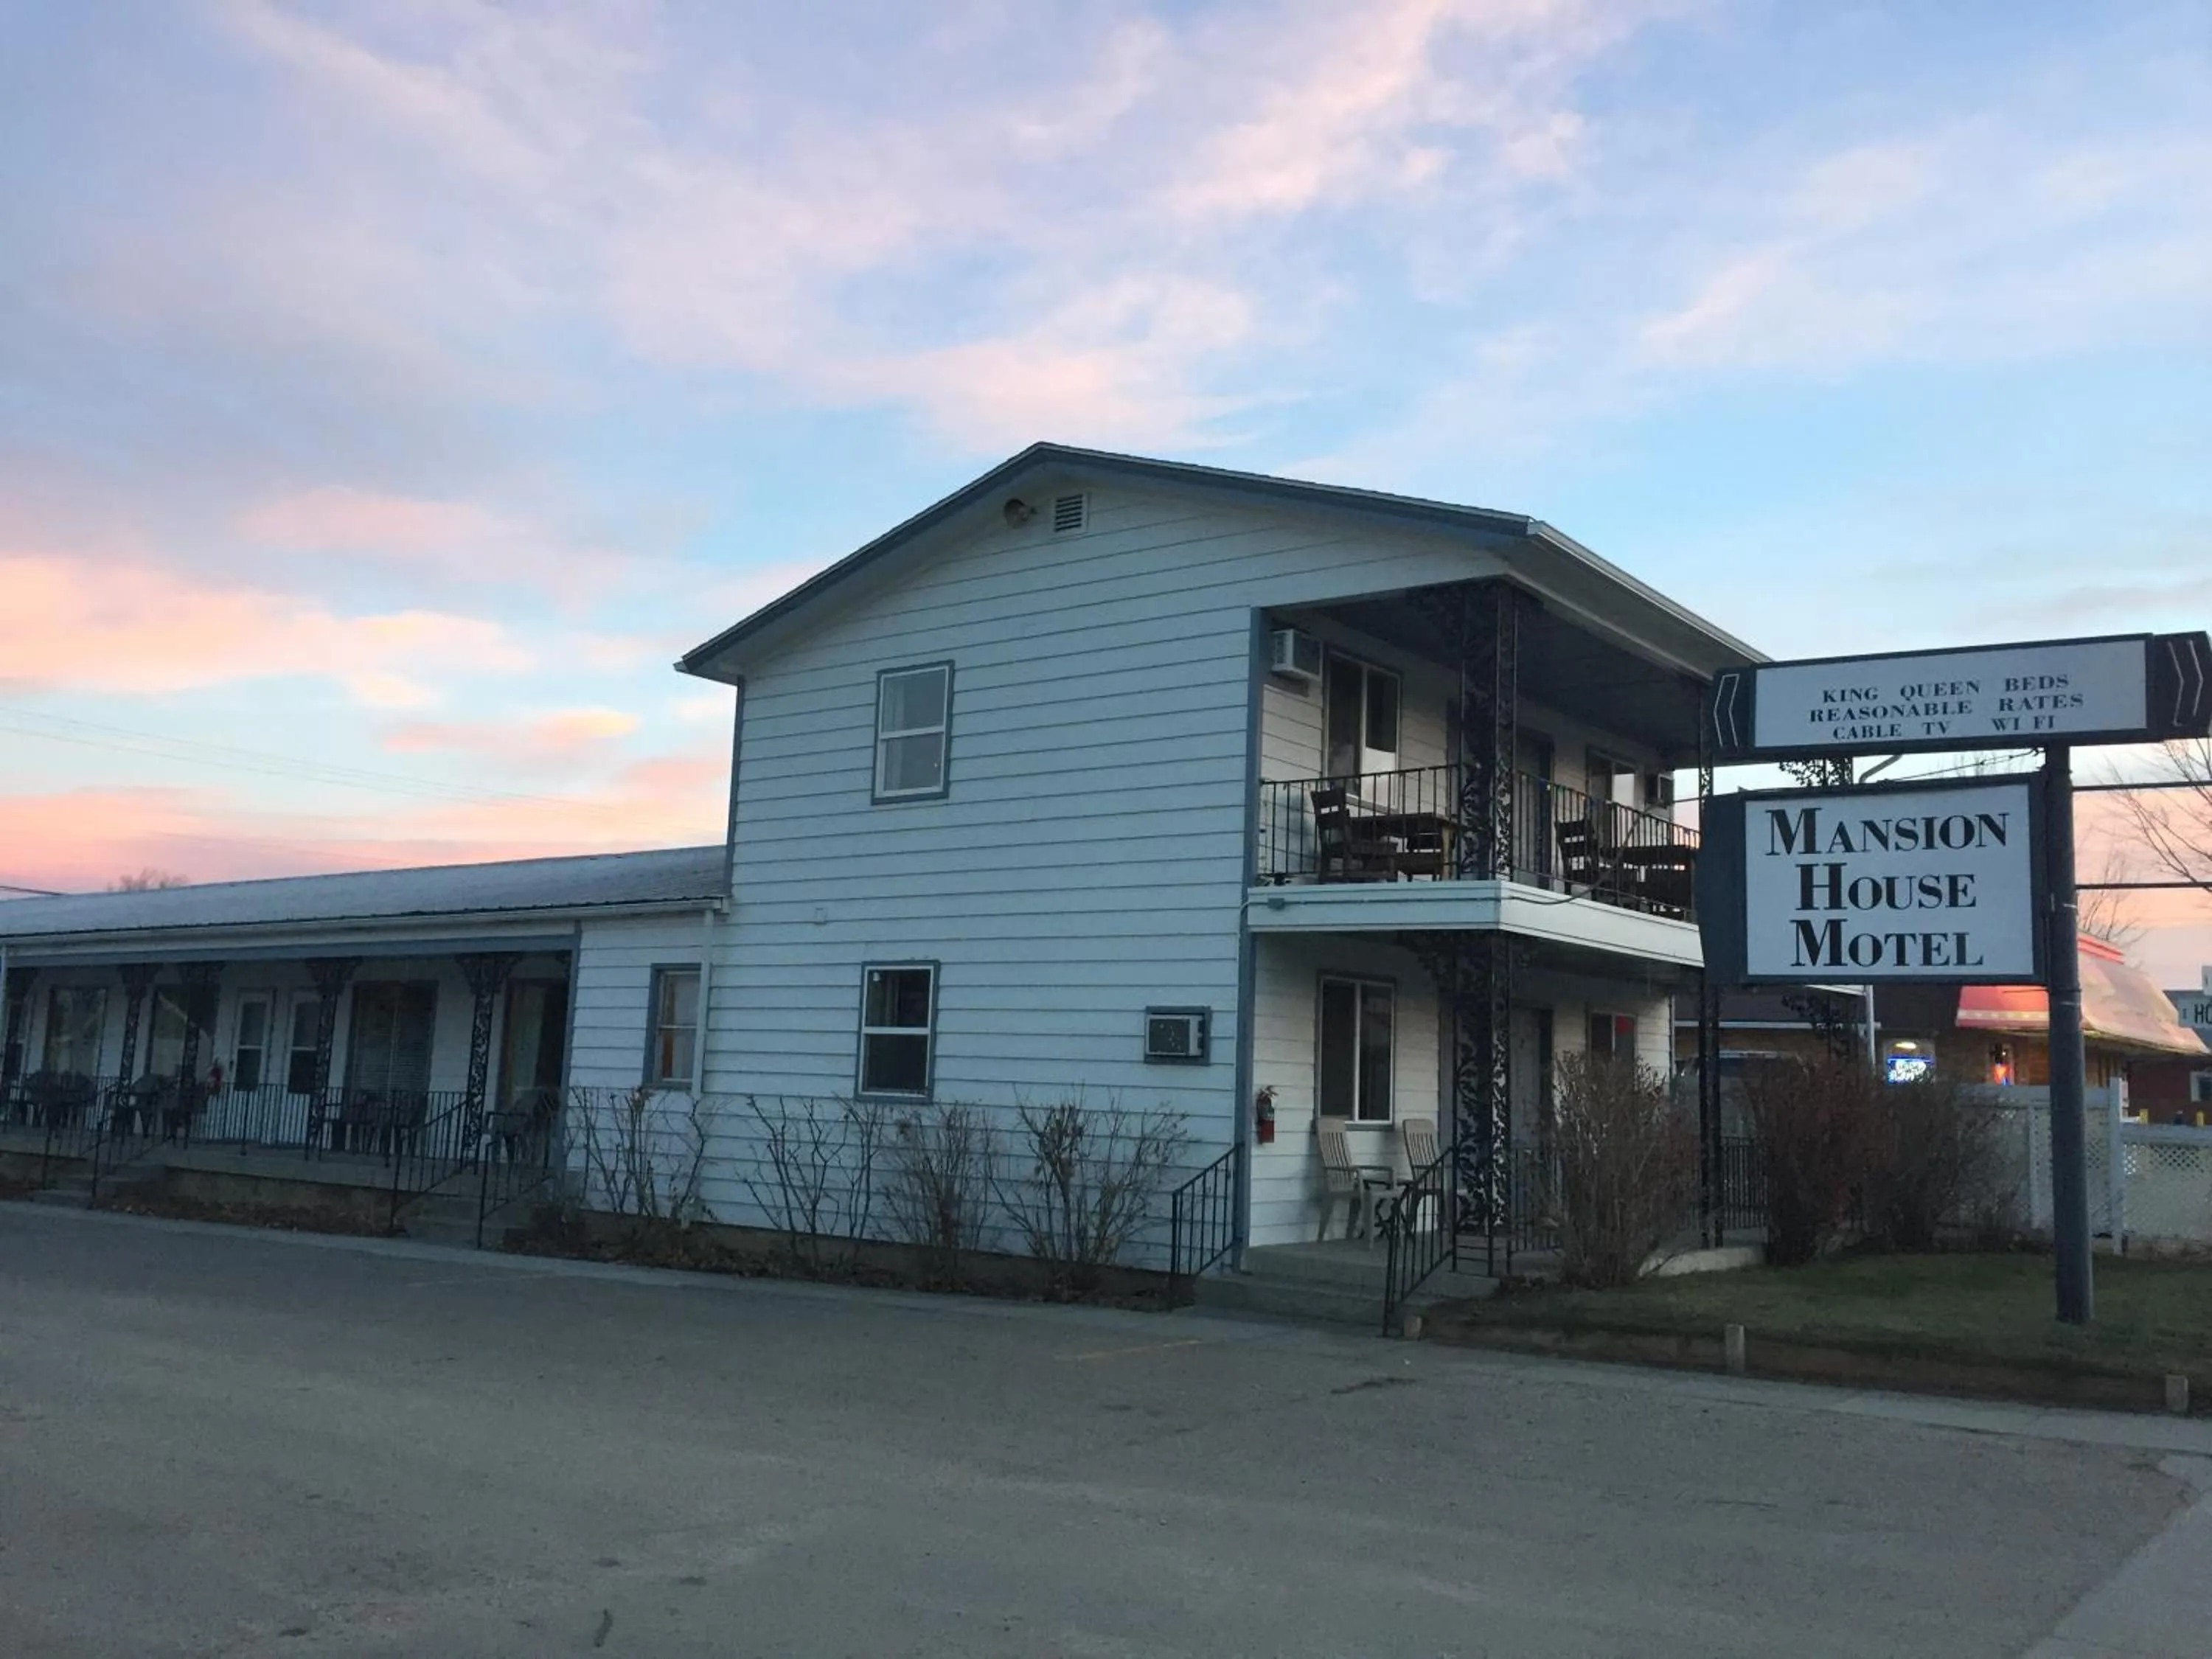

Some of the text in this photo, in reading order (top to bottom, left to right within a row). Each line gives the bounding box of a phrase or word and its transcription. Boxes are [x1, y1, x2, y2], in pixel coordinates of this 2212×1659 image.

[1823, 674, 2069, 703] KING QUEEN BEDS
[1809, 693, 2083, 723] REASONABLE RATES
[1832, 723, 1902, 740] CABLE
[1922, 720, 1950, 735] TV
